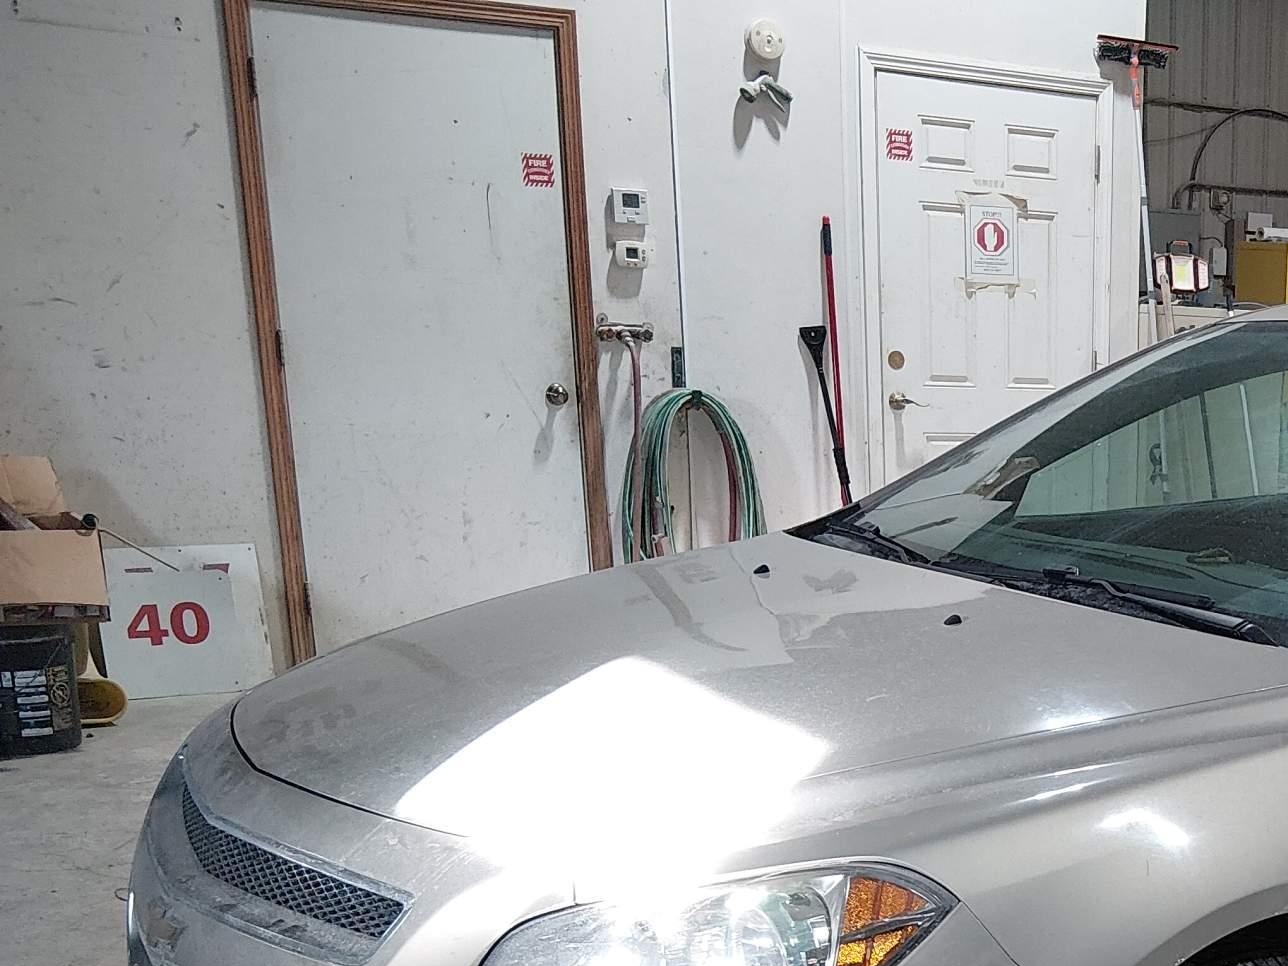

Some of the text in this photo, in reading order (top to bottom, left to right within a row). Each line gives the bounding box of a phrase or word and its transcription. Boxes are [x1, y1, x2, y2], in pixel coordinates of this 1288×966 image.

[892, 135, 908, 143] FIRE
[528, 159, 547, 167] FIRE
[127, 601, 211, 646] 40
